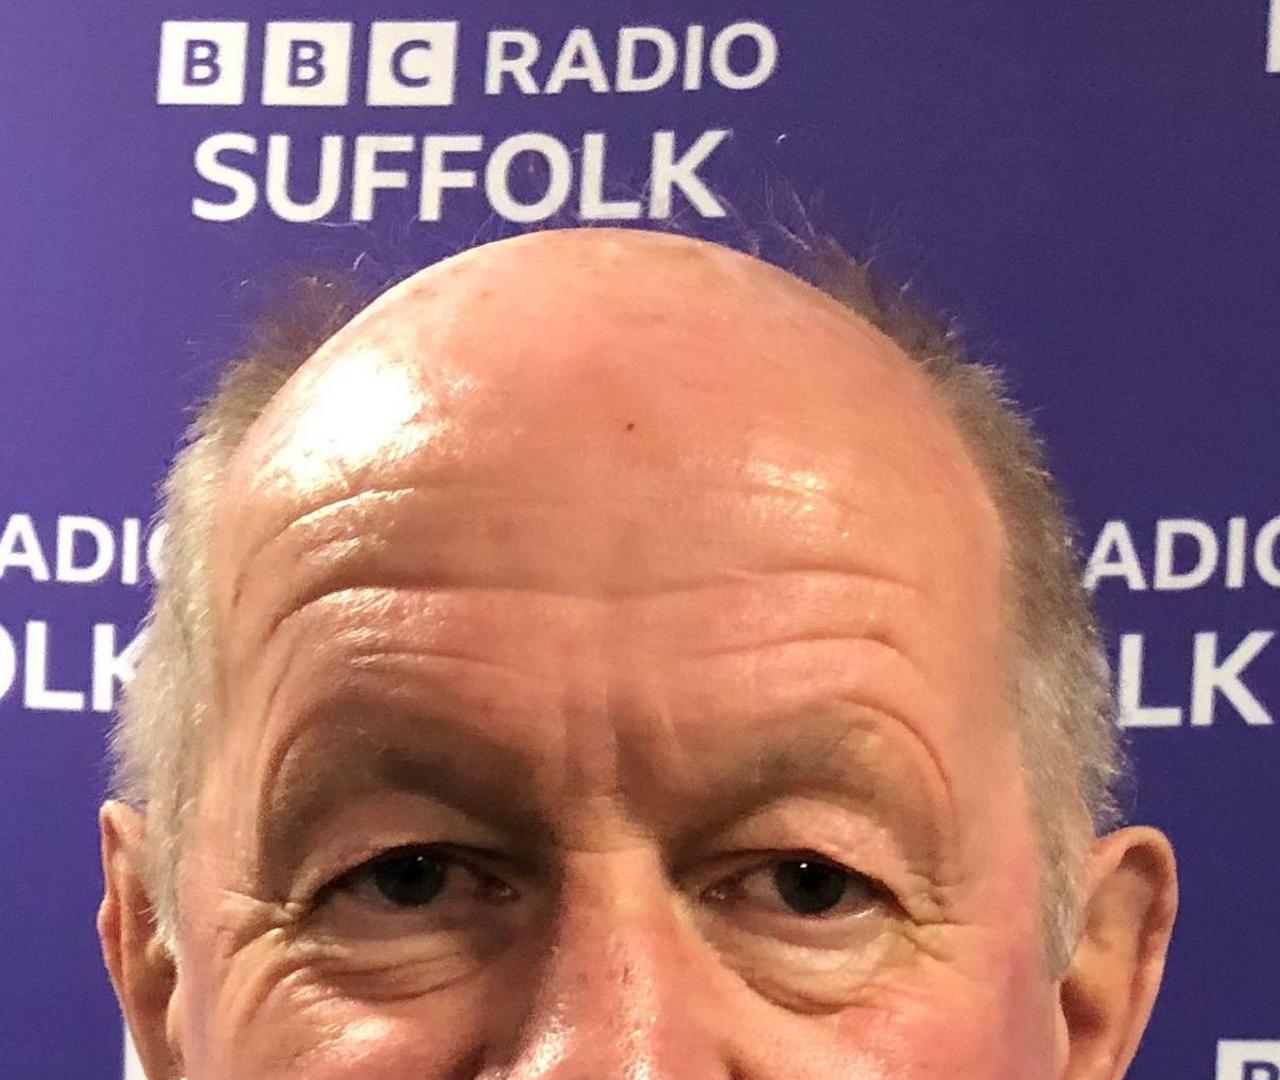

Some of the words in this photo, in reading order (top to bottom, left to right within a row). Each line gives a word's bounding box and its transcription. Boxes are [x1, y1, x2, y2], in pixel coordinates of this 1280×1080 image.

[156, 20, 458, 105] BBC
[484, 22, 778, 94] RADIO
[192, 129, 729, 222] SUFFOLK
